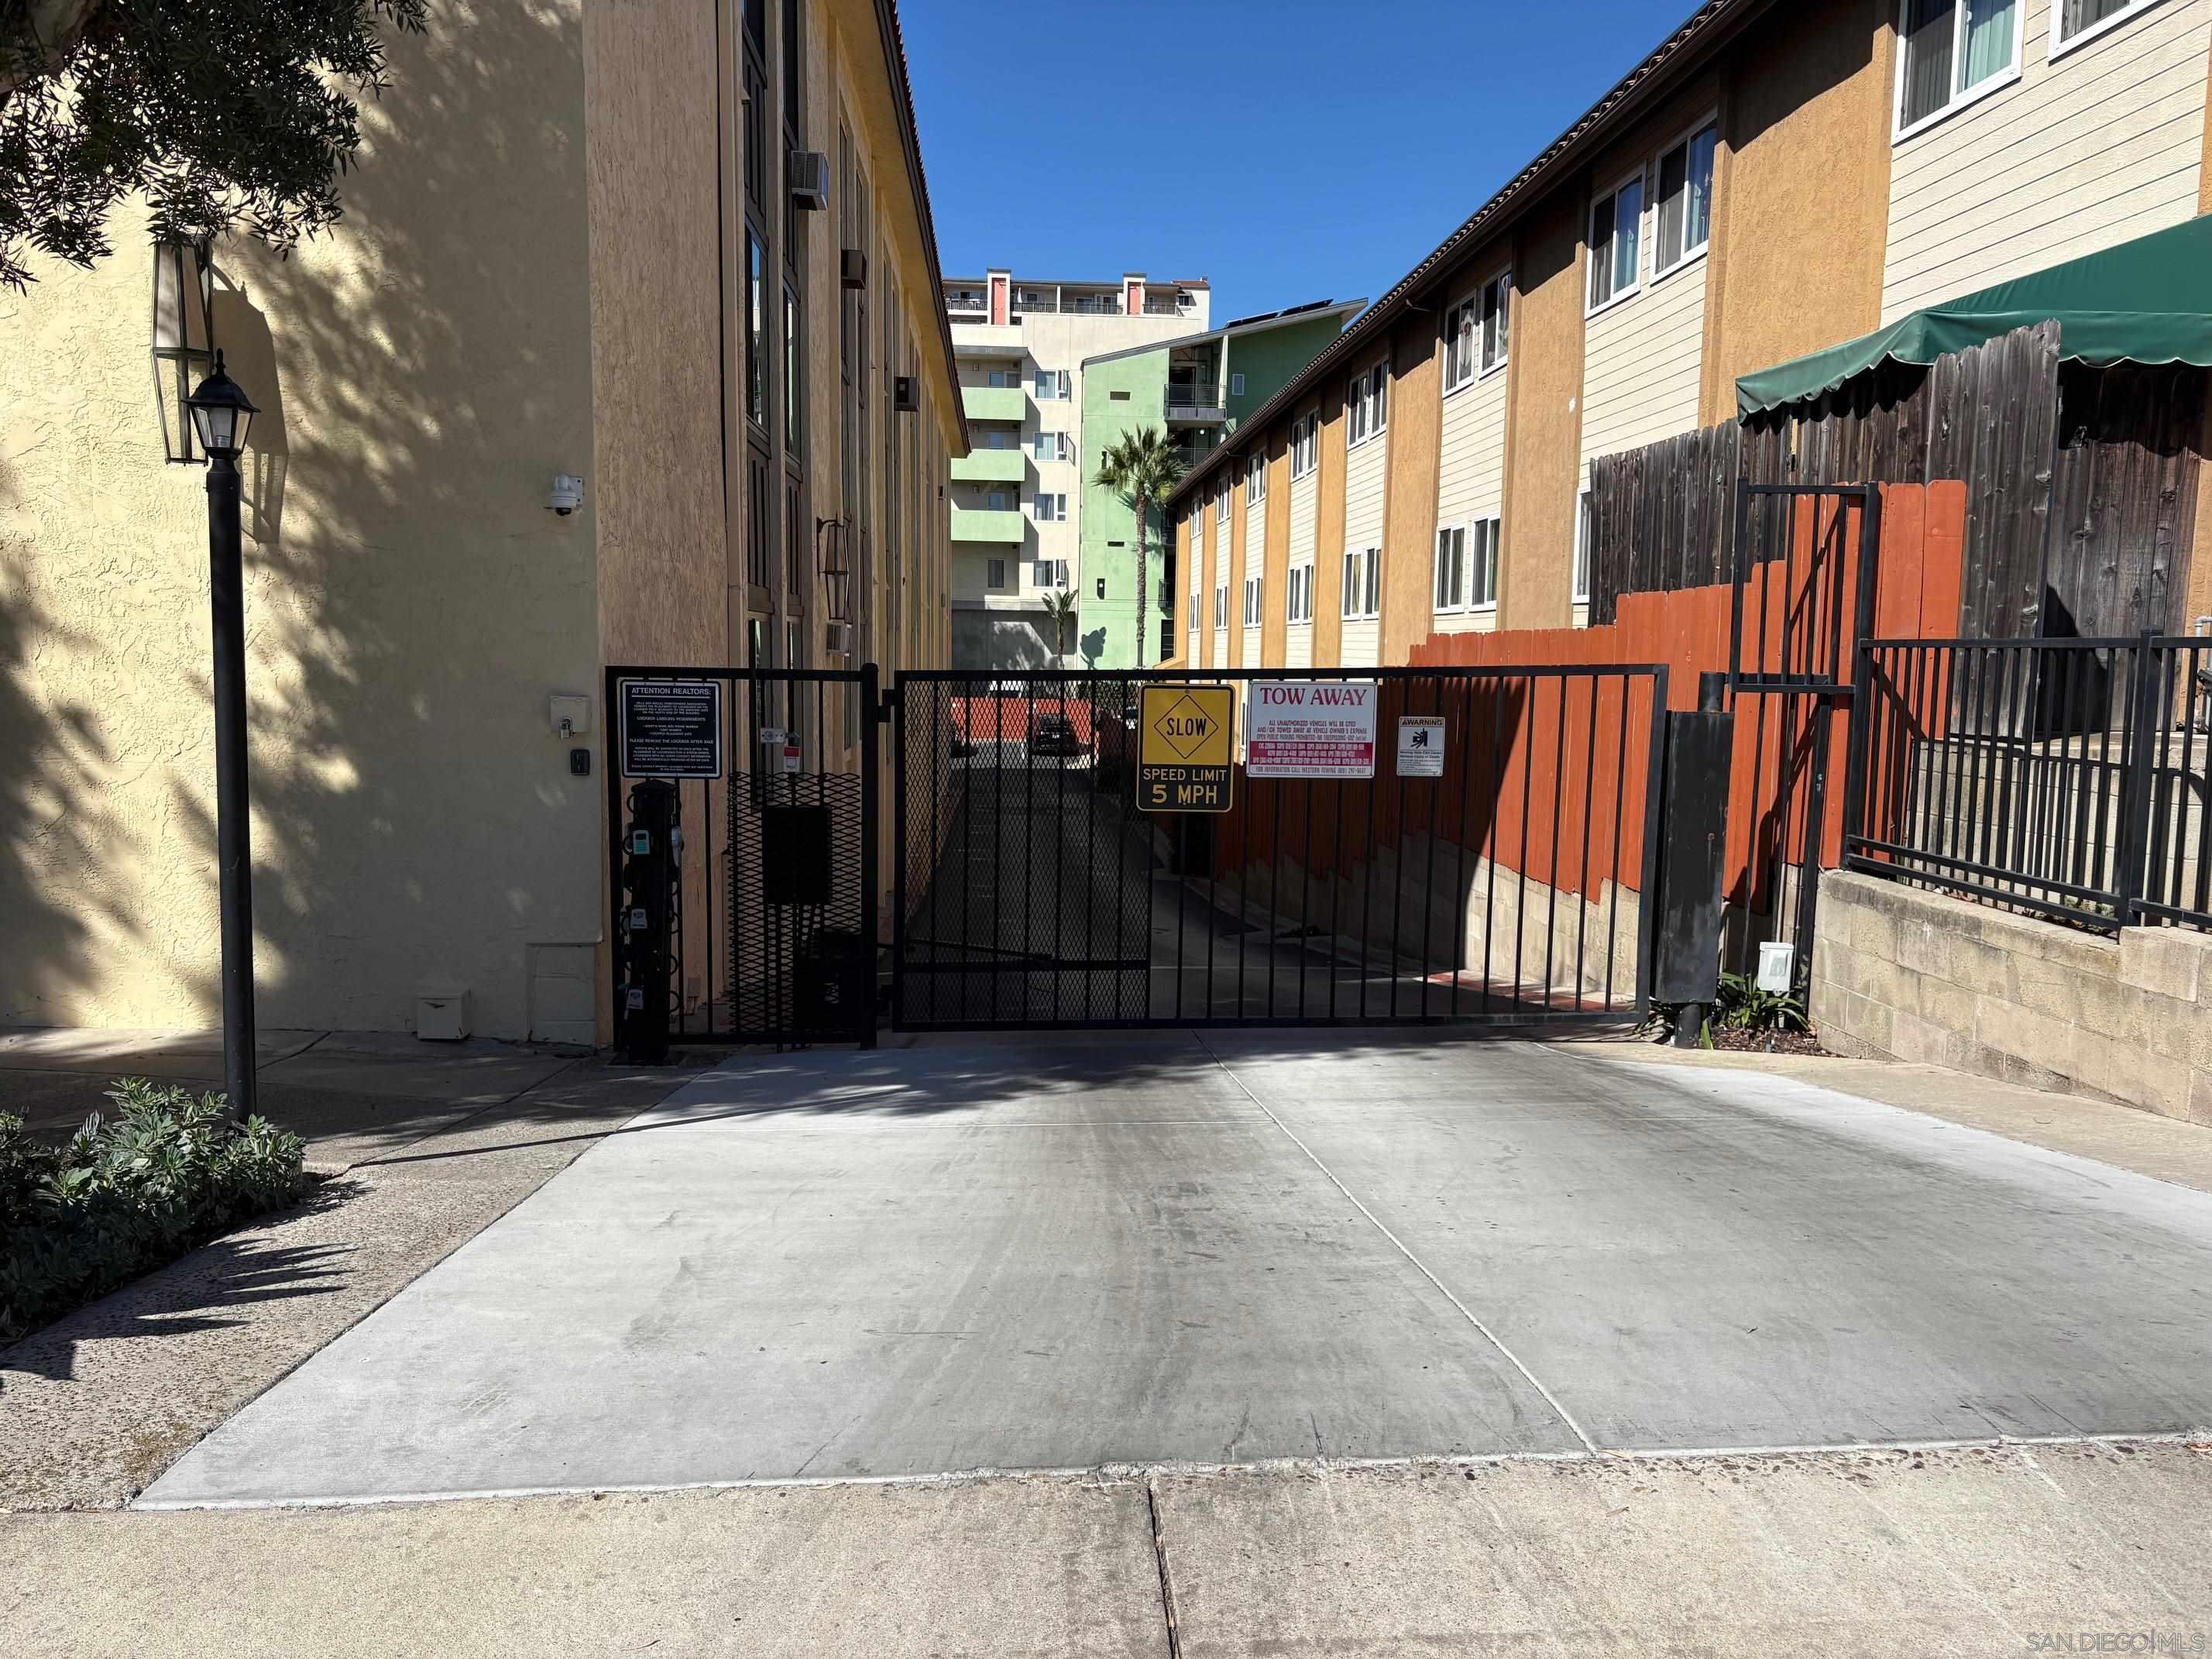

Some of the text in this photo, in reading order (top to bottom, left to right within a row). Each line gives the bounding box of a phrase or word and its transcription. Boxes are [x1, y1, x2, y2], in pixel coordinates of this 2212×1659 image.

[672, 687, 711, 696] REALTORS:
[1259, 686, 1368, 706] TOW AWAY
[1166, 717, 1207, 737] SLOW
[1142, 768, 1228, 782] SPEED LIMIT
[1152, 784, 1218, 805] 5 MPH
